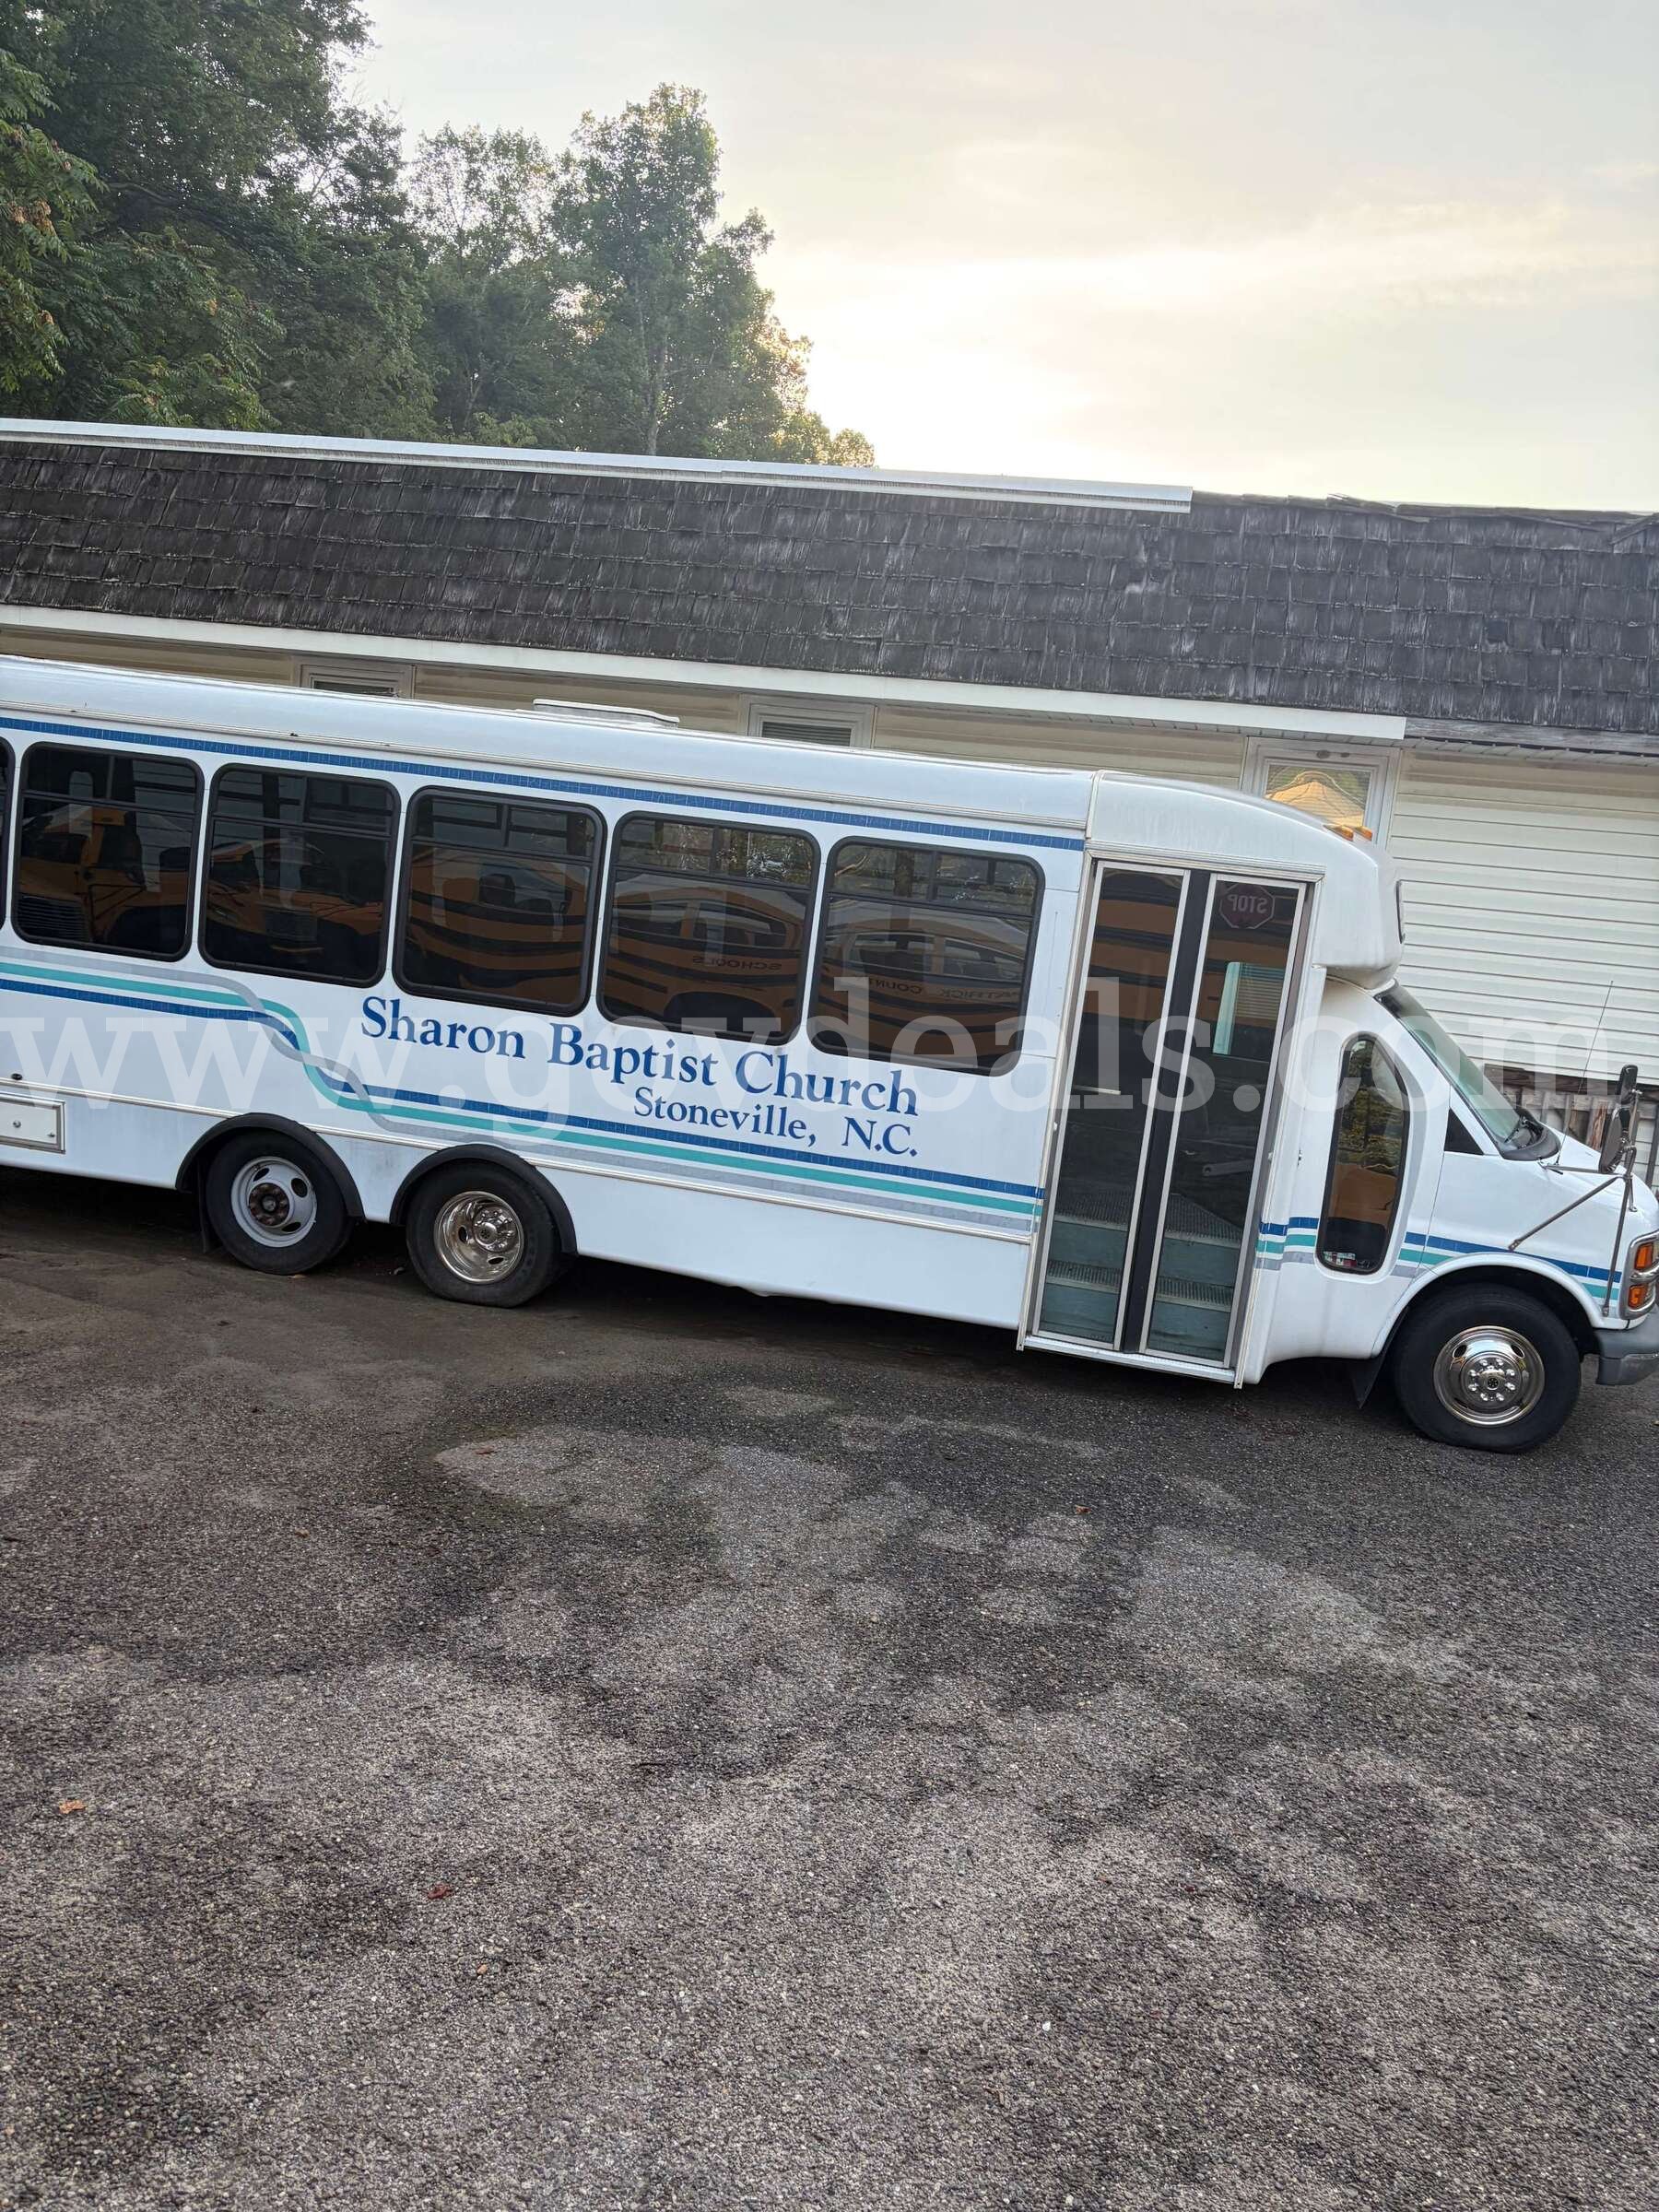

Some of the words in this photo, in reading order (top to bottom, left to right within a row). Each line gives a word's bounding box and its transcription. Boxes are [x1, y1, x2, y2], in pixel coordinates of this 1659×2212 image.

[361, 996, 526, 1059] Sharon
[547, 1022, 719, 1085] Baptist
[735, 1051, 919, 1116] Church
[633, 1086, 818, 1147] Stoneville,
[841, 1116, 918, 1158] N.C.
